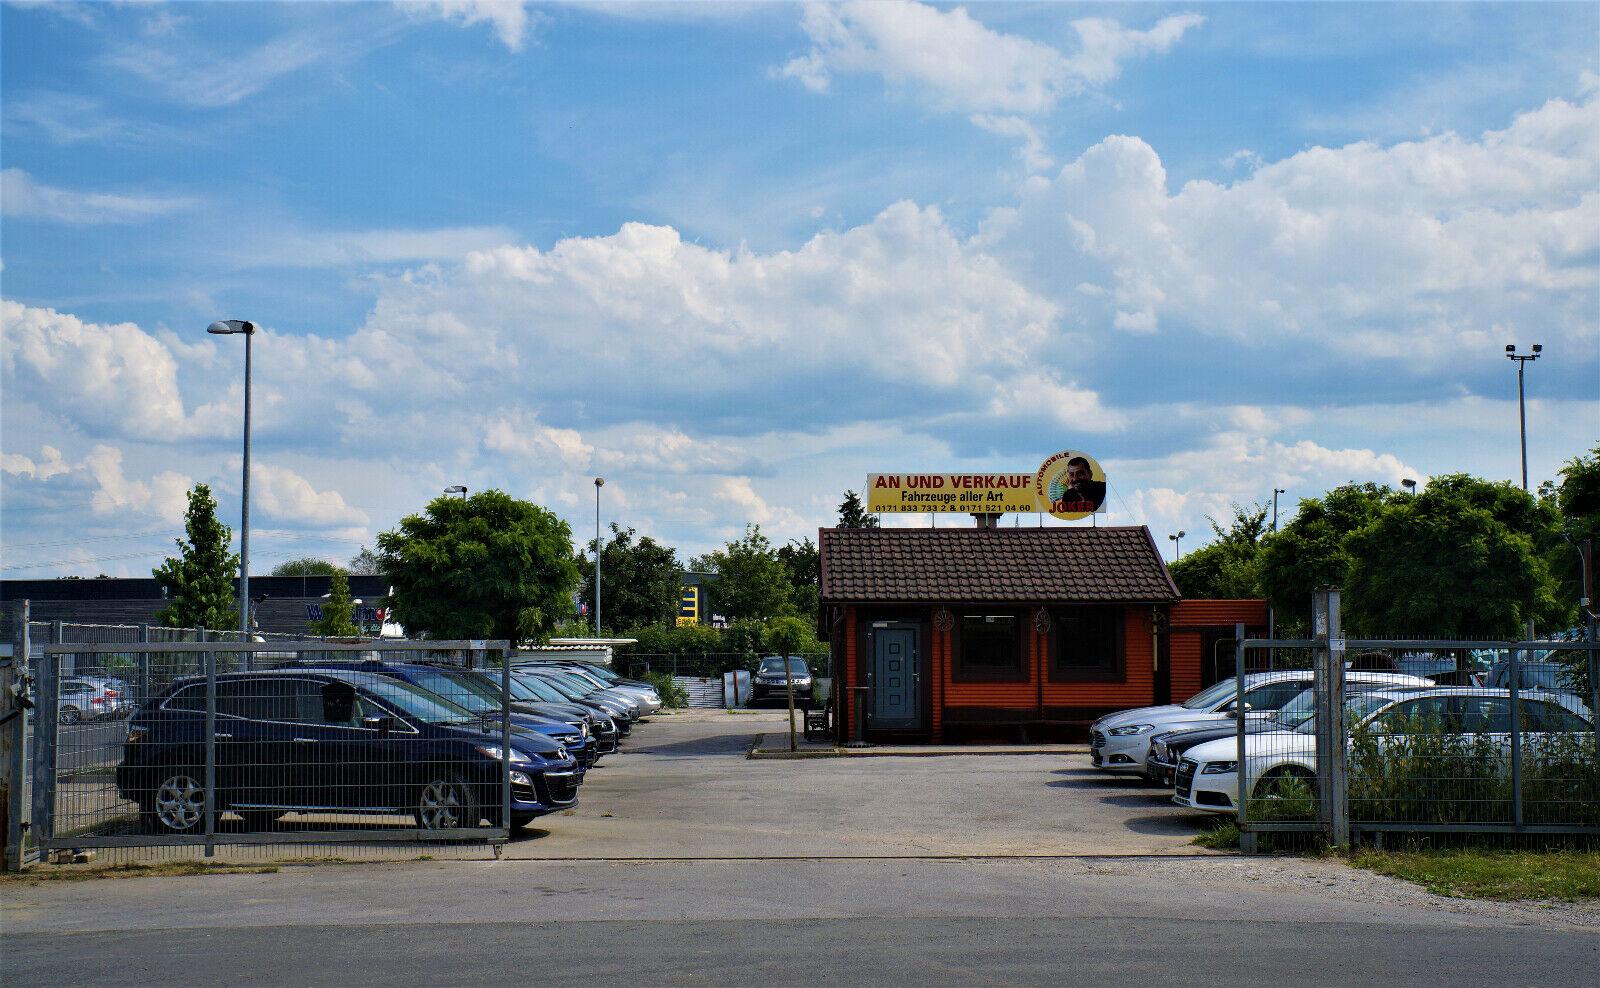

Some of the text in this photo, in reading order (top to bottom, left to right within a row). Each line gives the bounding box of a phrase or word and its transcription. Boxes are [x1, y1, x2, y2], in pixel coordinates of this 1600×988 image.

[1036, 452, 1070, 496] AUTOMOBILE
[875, 476, 1031, 488] AN UND VERKAUF
[901, 490, 1004, 504] Fahrzeuge aller Art
[875, 504, 1031, 512] 0171 833 733 2 & 0171 521 04 60
[1048, 500, 1094, 514] JOKER
